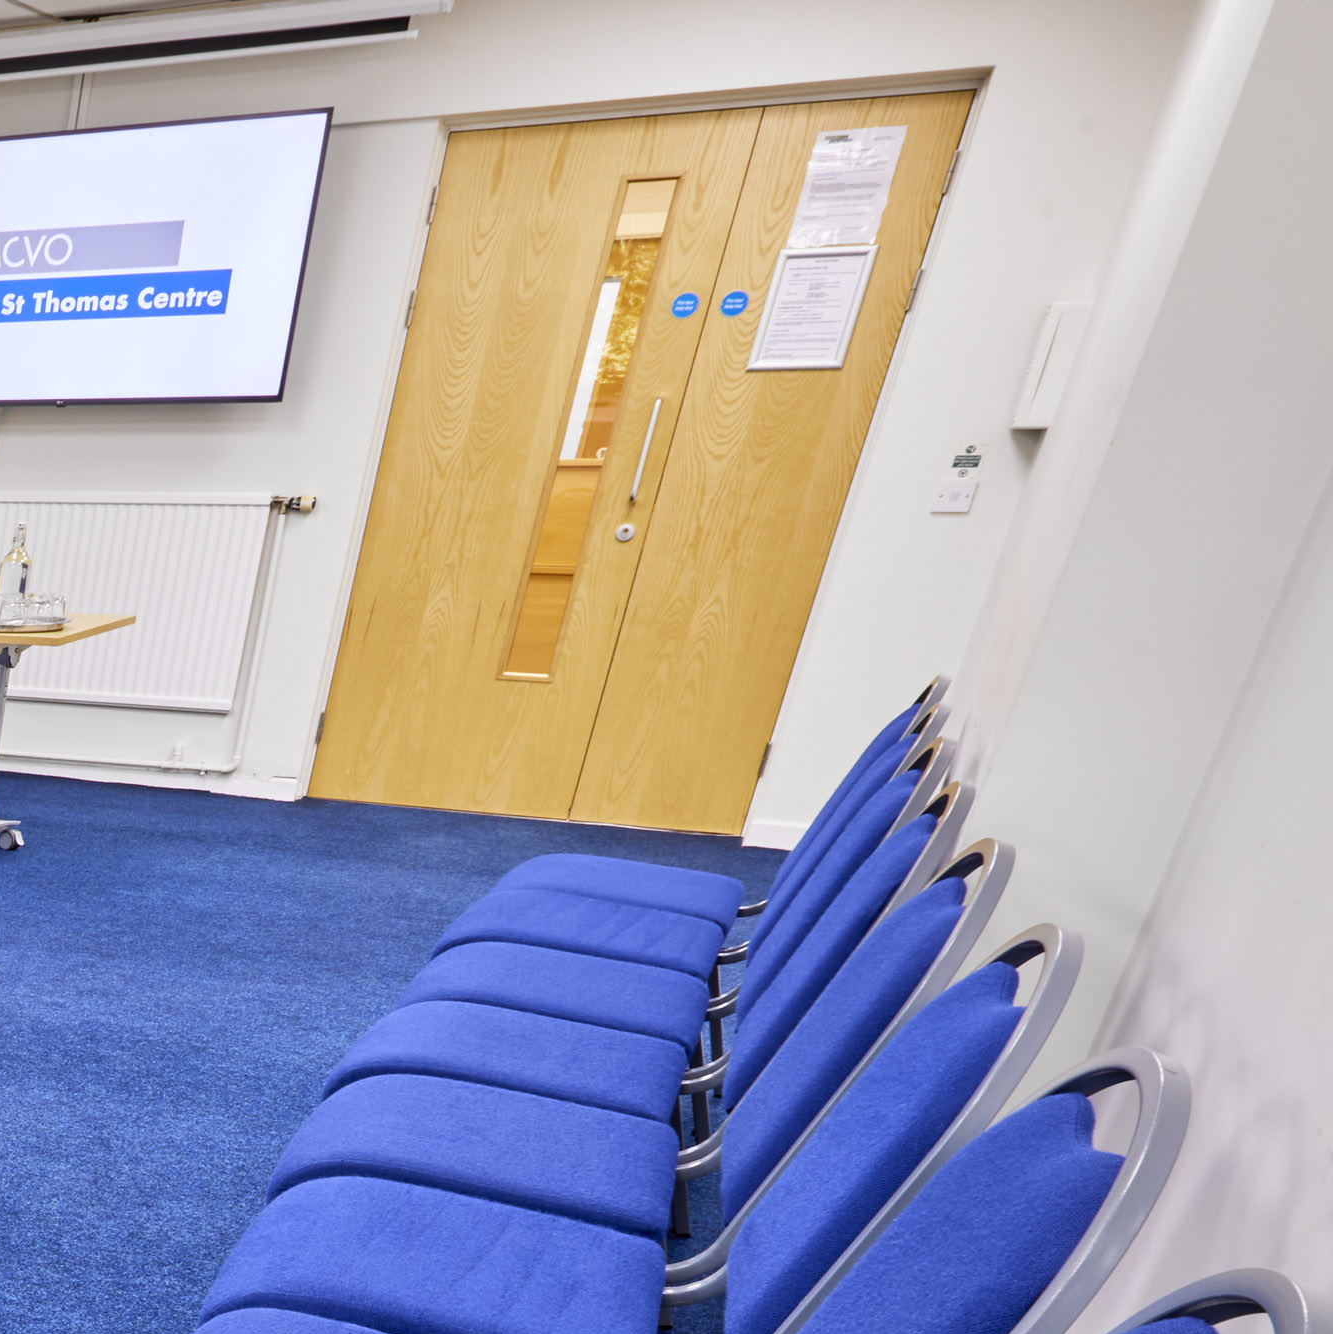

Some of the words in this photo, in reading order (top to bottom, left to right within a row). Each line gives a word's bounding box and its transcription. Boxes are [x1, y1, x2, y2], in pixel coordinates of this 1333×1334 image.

[1, 293, 25, 315] St
[33, 290, 128, 314] Thomas
[137, 287, 223, 309] Centre
